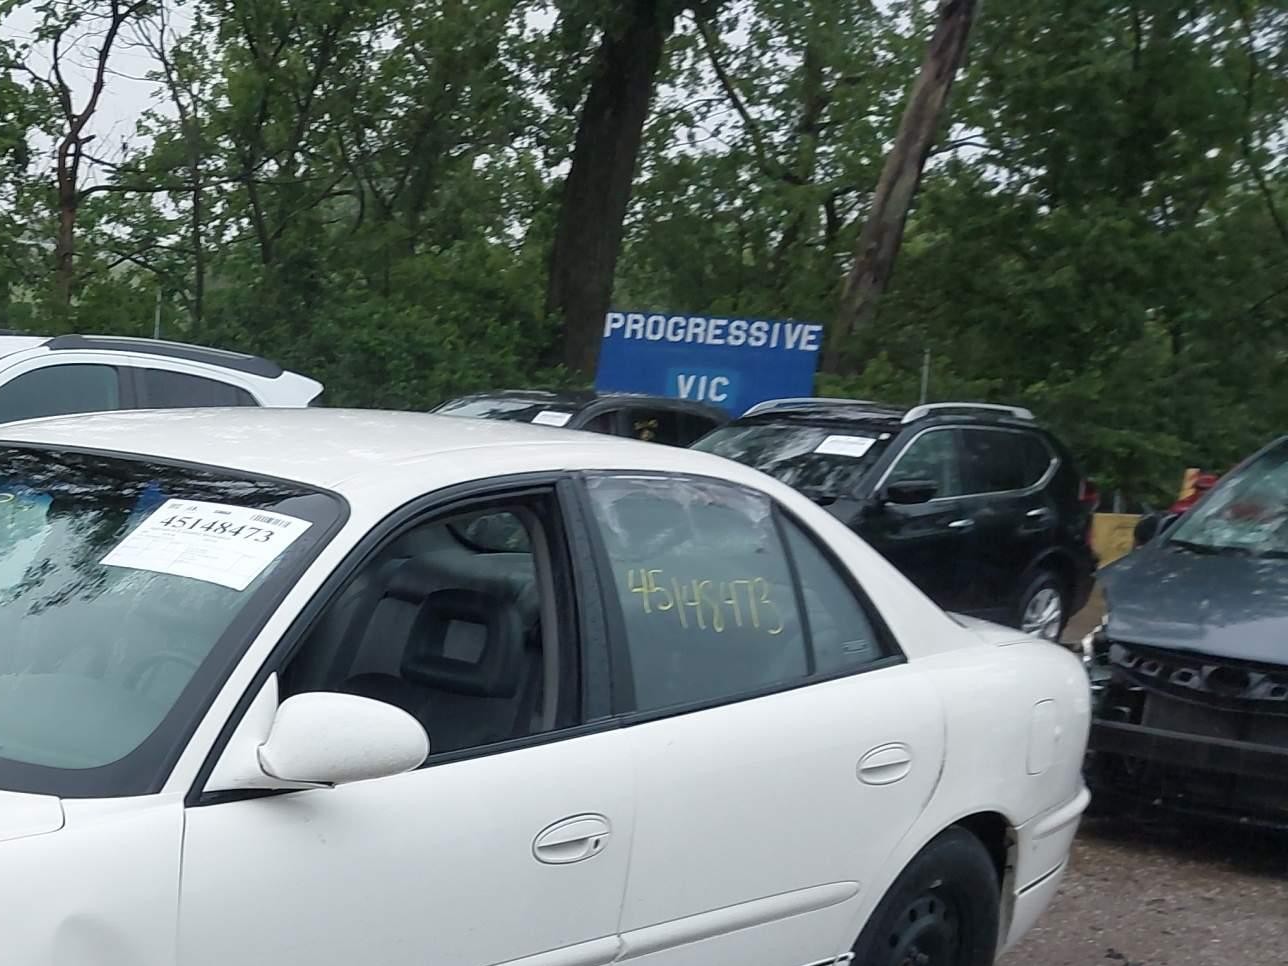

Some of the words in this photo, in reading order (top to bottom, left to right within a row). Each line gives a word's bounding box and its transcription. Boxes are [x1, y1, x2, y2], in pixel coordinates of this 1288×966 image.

[603, 312, 823, 351] PROGRESSIVE
[676, 374, 730, 402] VIC
[159, 515, 275, 543] 45148473
[627, 568, 784, 634] 45148473
